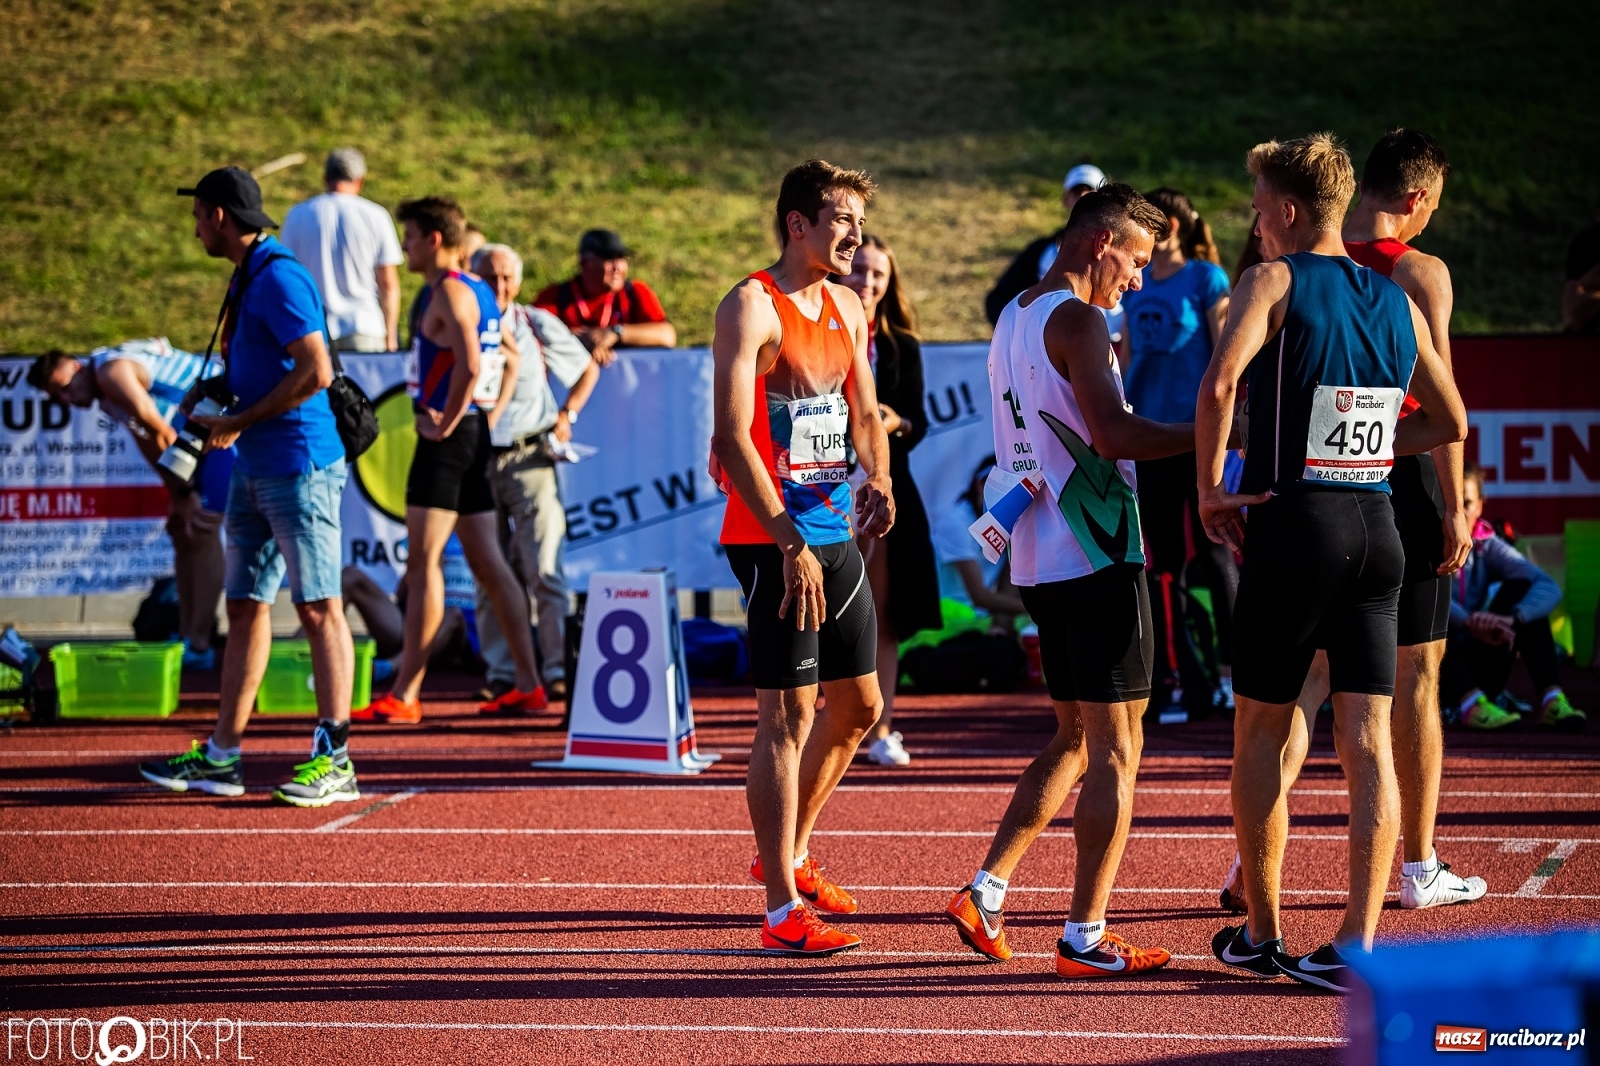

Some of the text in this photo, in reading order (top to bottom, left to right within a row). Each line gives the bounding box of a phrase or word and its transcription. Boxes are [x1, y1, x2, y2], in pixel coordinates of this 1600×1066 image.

[1355, 401, 1385, 409] Racibórz
[1324, 420, 1384, 456] 450
[1316, 469, 1384, 482] RACIBÓRZ 2019
[595, 609, 651, 724] 8
